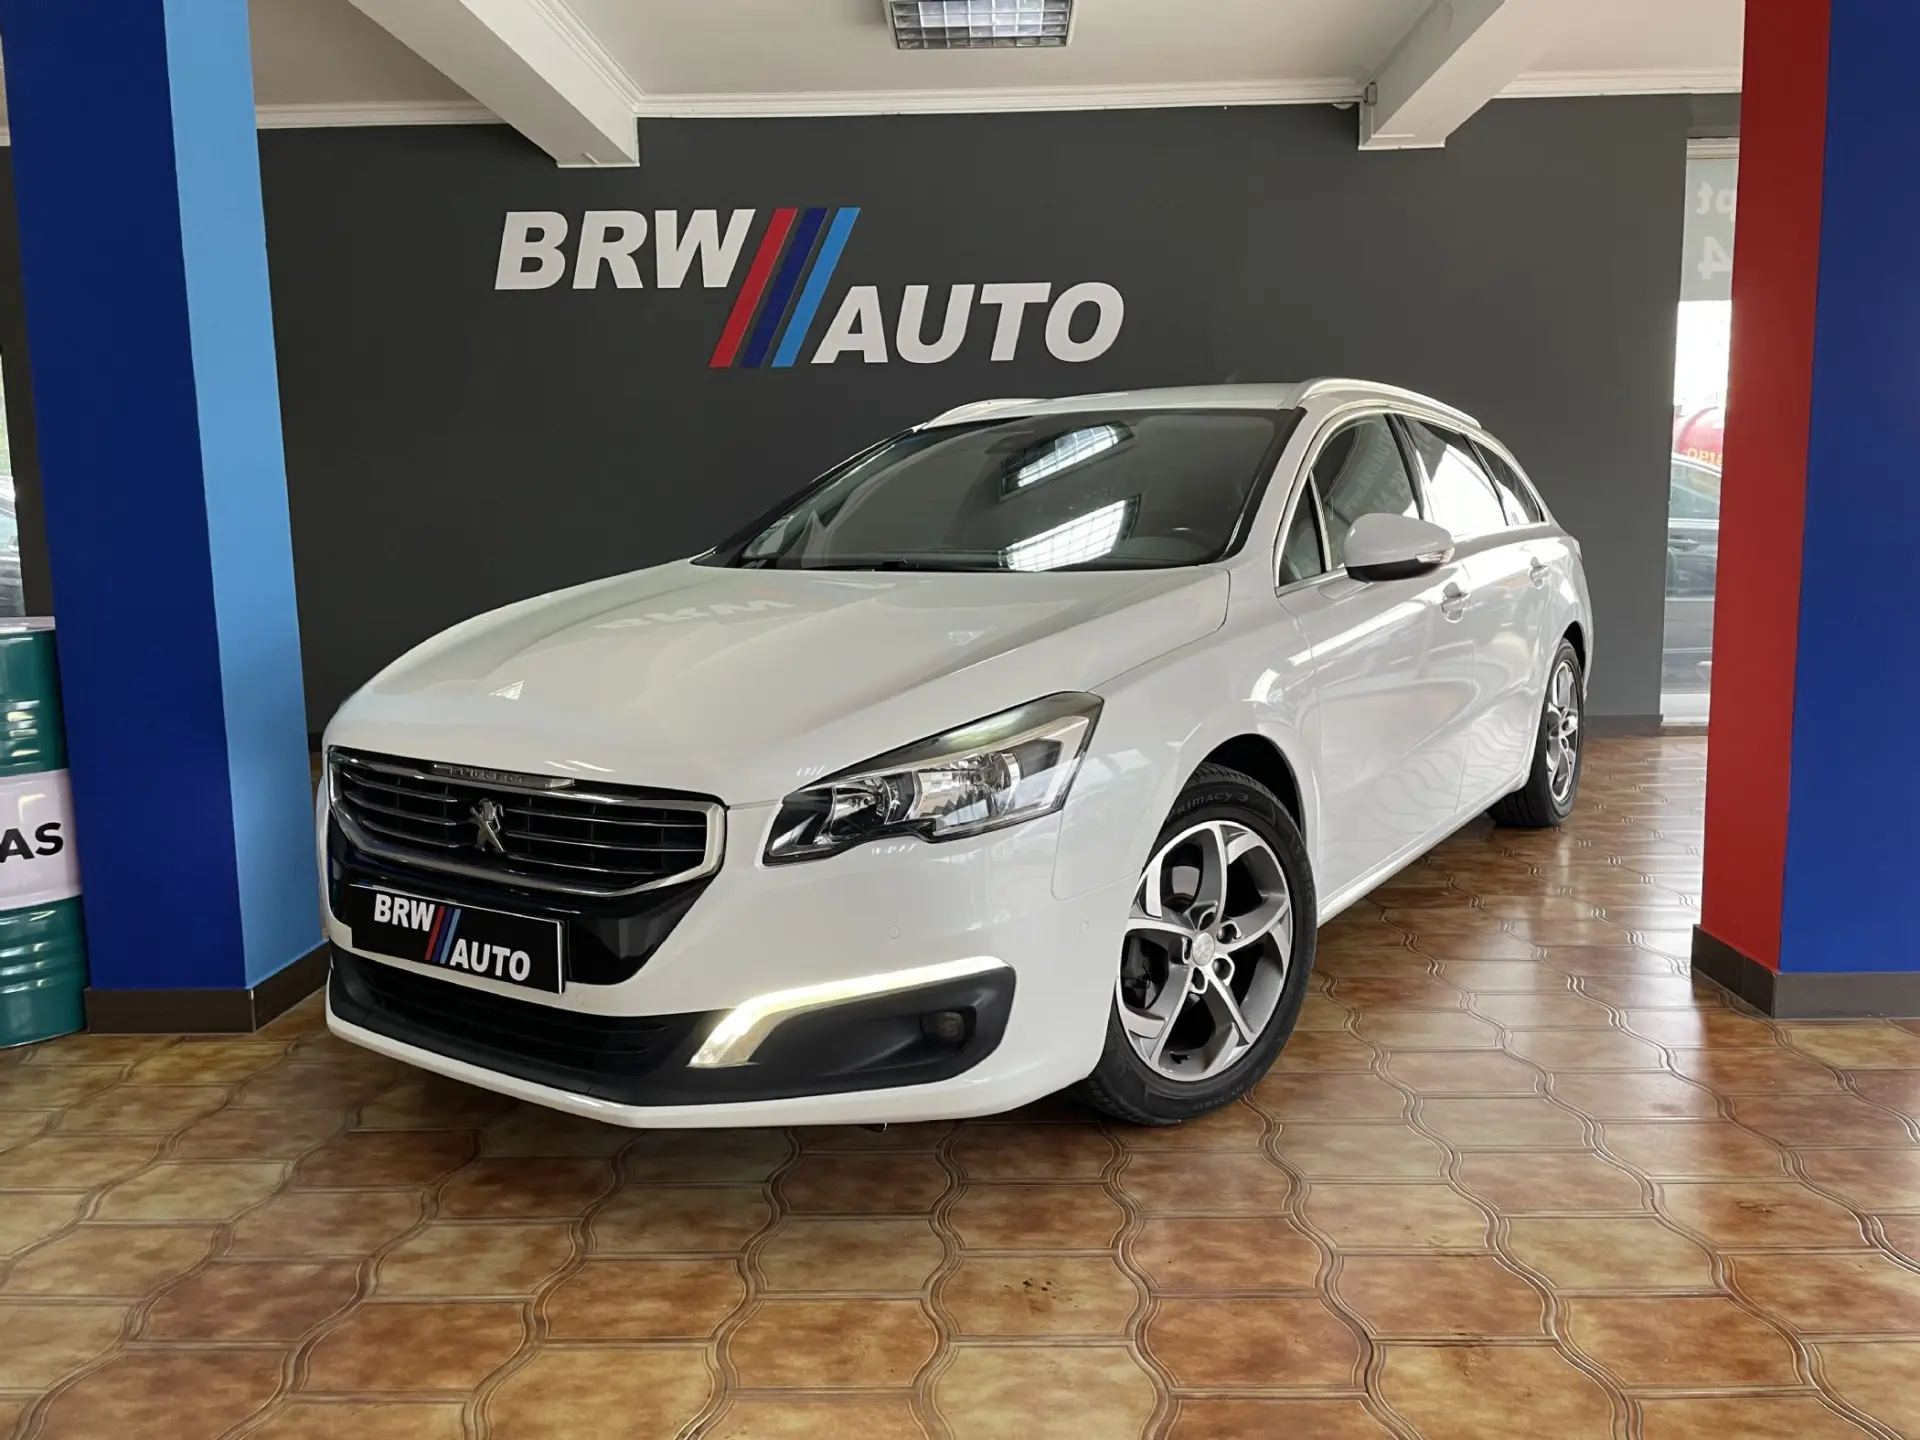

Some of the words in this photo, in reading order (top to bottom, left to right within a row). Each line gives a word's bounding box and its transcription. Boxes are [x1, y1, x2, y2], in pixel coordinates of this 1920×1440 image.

[494, 208, 756, 290] BRW
[810, 282, 1124, 364] AUTO
[374, 893, 435, 932] BRW
[450, 938, 531, 982] AUTO
